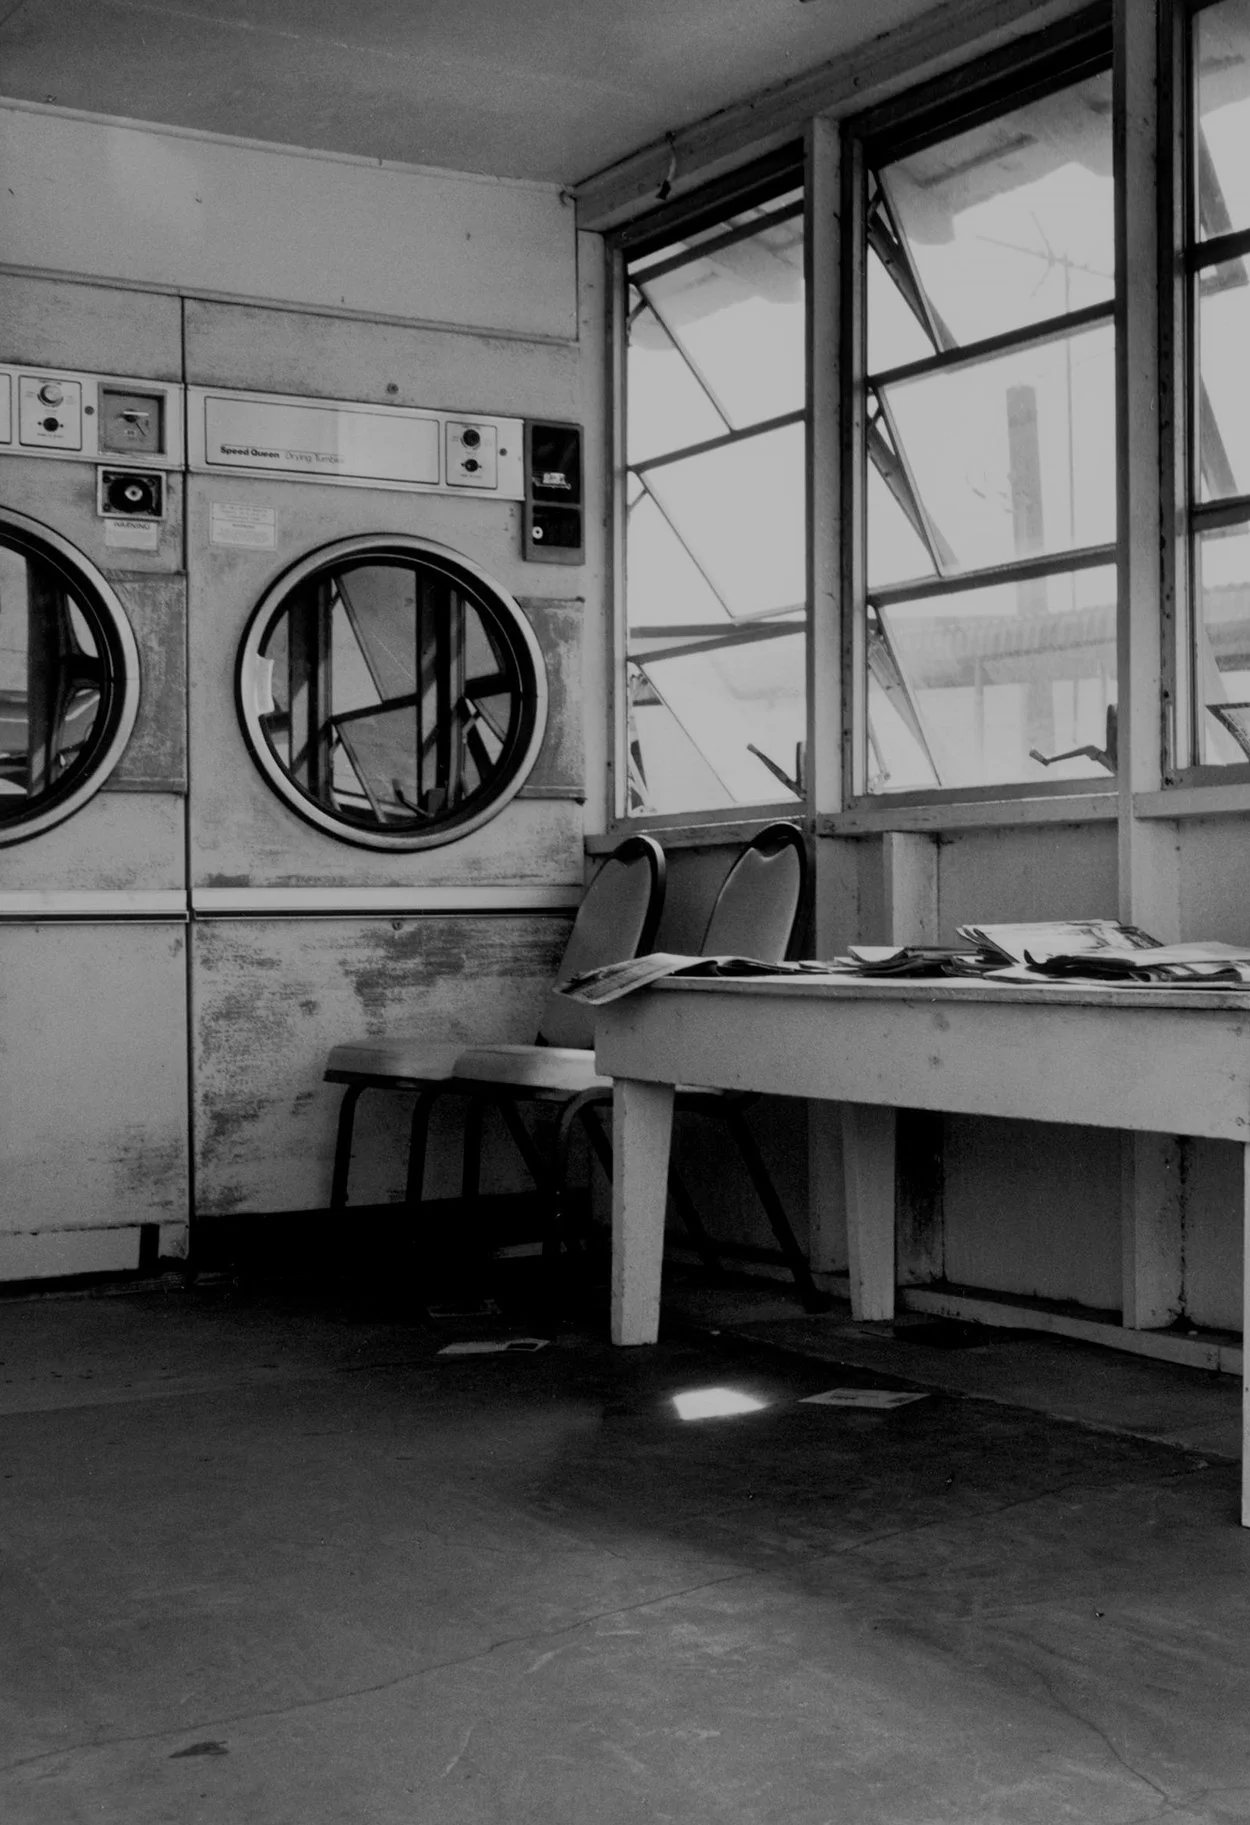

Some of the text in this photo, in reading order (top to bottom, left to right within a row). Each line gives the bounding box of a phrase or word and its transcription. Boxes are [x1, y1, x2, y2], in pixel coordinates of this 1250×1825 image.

[220, 445, 249, 456] Speed
[250, 448, 280, 459] Queen
[112, 521, 150, 529] WARNING
